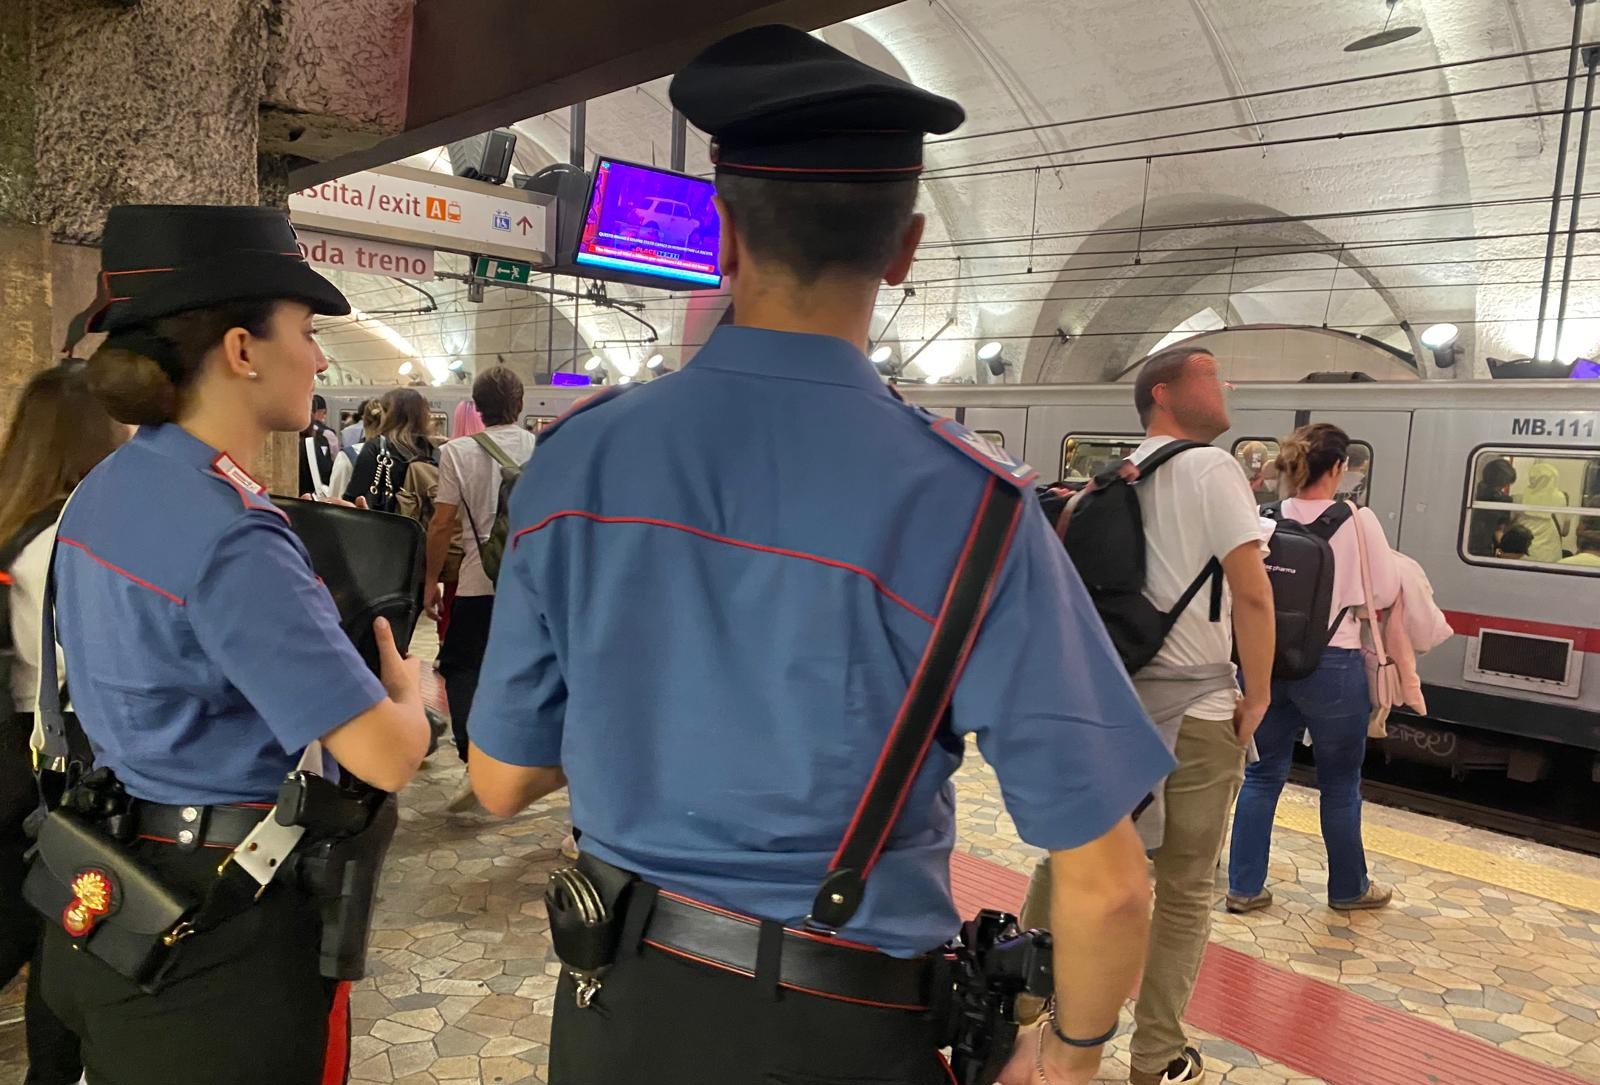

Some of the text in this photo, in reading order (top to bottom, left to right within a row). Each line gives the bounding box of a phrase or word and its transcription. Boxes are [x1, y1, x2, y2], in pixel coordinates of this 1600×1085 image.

[430, 200, 443, 219] A
[356, 247, 427, 276] treno
[1511, 418, 1595, 438] MB.111
